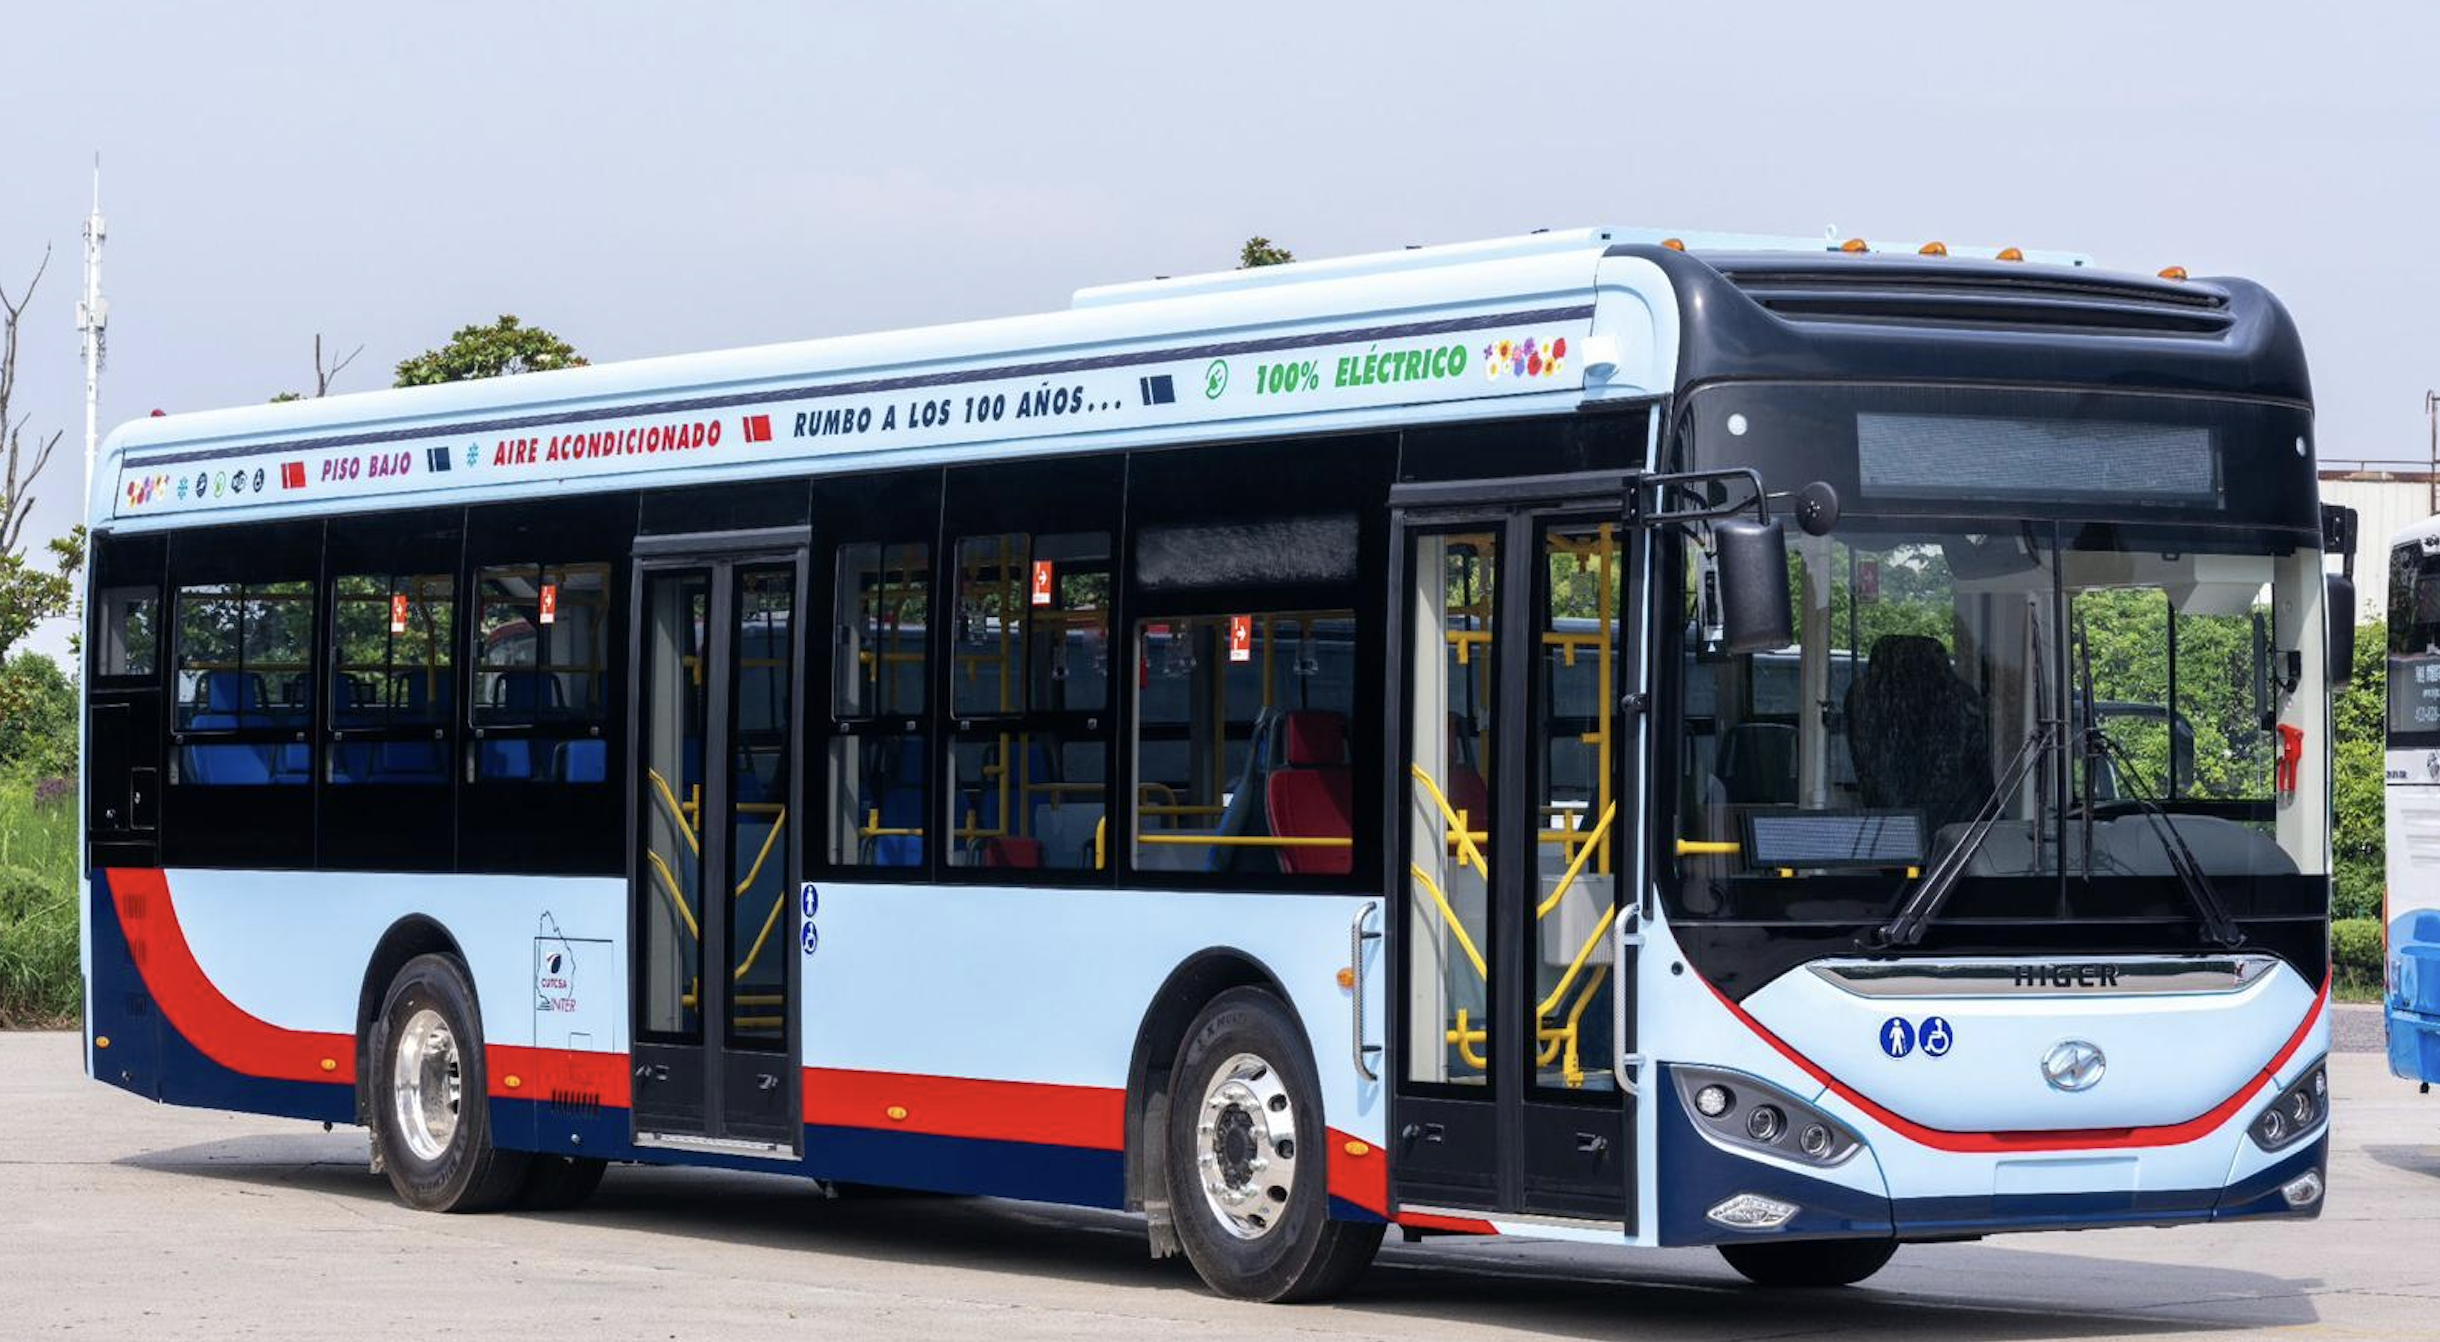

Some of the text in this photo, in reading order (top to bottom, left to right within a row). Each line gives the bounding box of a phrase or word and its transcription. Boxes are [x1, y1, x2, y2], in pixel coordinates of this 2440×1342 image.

[1256, 344, 1468, 395] 100% ELÉCTRICO
[793, 381, 1123, 438] RUMBO A LOS 100 AÑOS...
[493, 419, 722, 467] AIRE ACONDICIONADO
[321, 451, 412, 482] PISO BAJO
[541, 978, 567, 989] CUTCSA
[2014, 964, 2119, 987] HIGER
